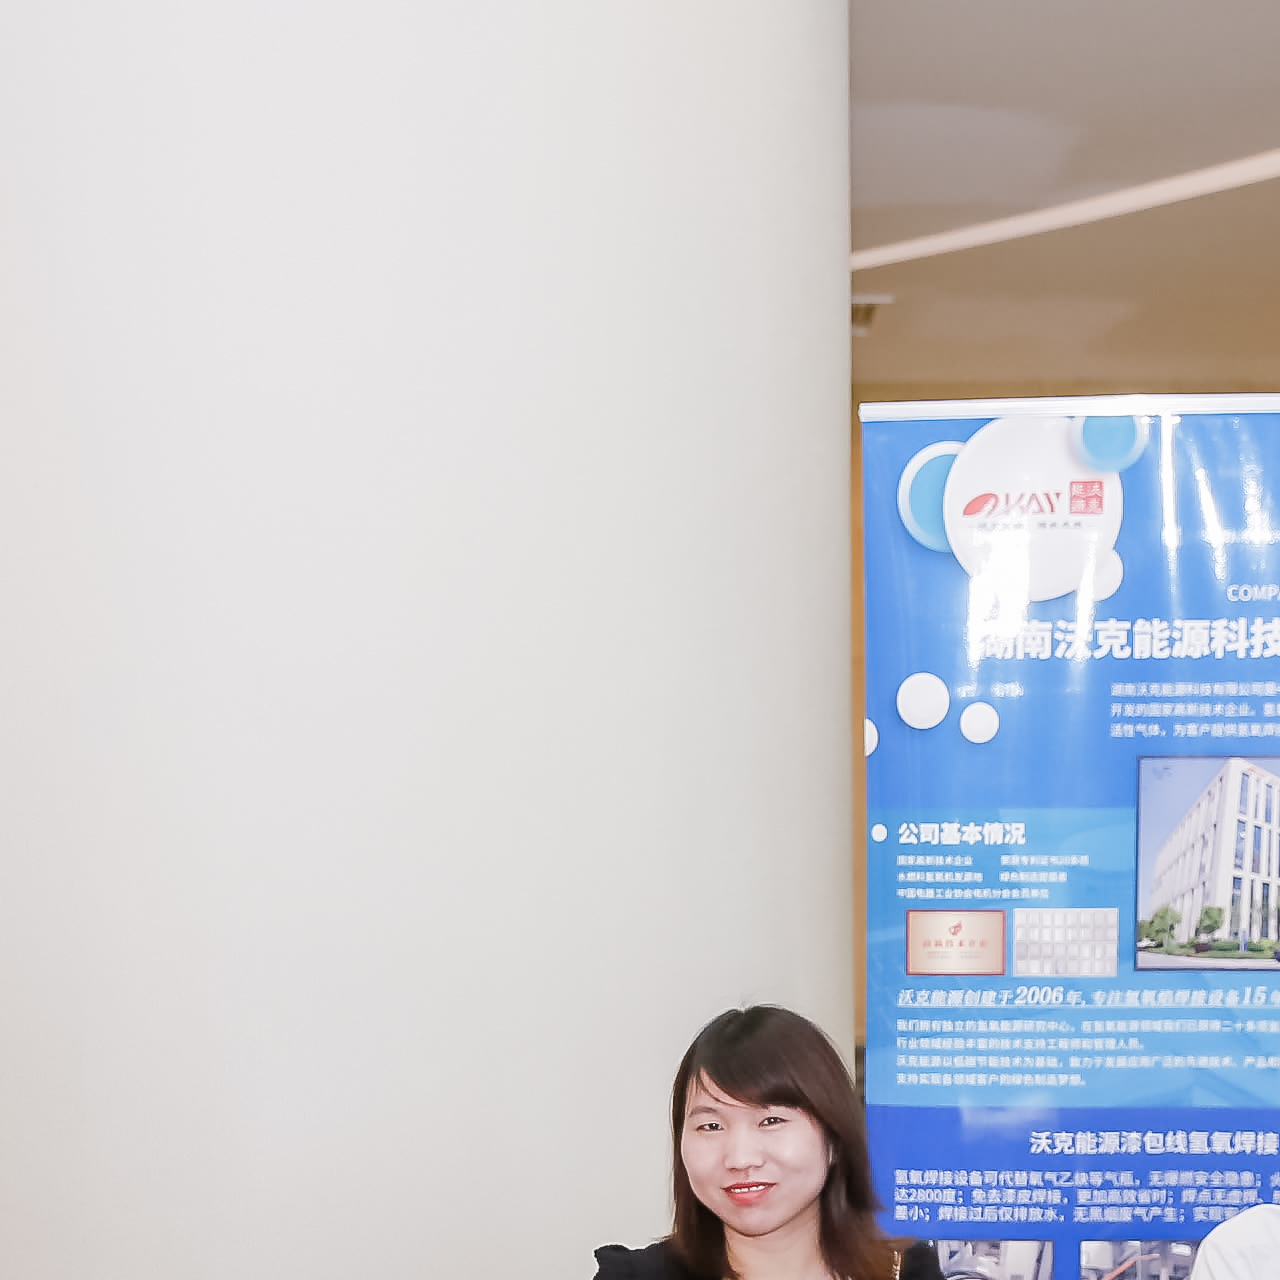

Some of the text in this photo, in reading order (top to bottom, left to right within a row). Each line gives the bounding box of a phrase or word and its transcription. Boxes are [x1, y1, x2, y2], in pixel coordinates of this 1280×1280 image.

[898, 822, 1026, 845] 公司基本情况
[1029, 1130, 1280, 1155] 沃克能源漆包线氢氧焊接
